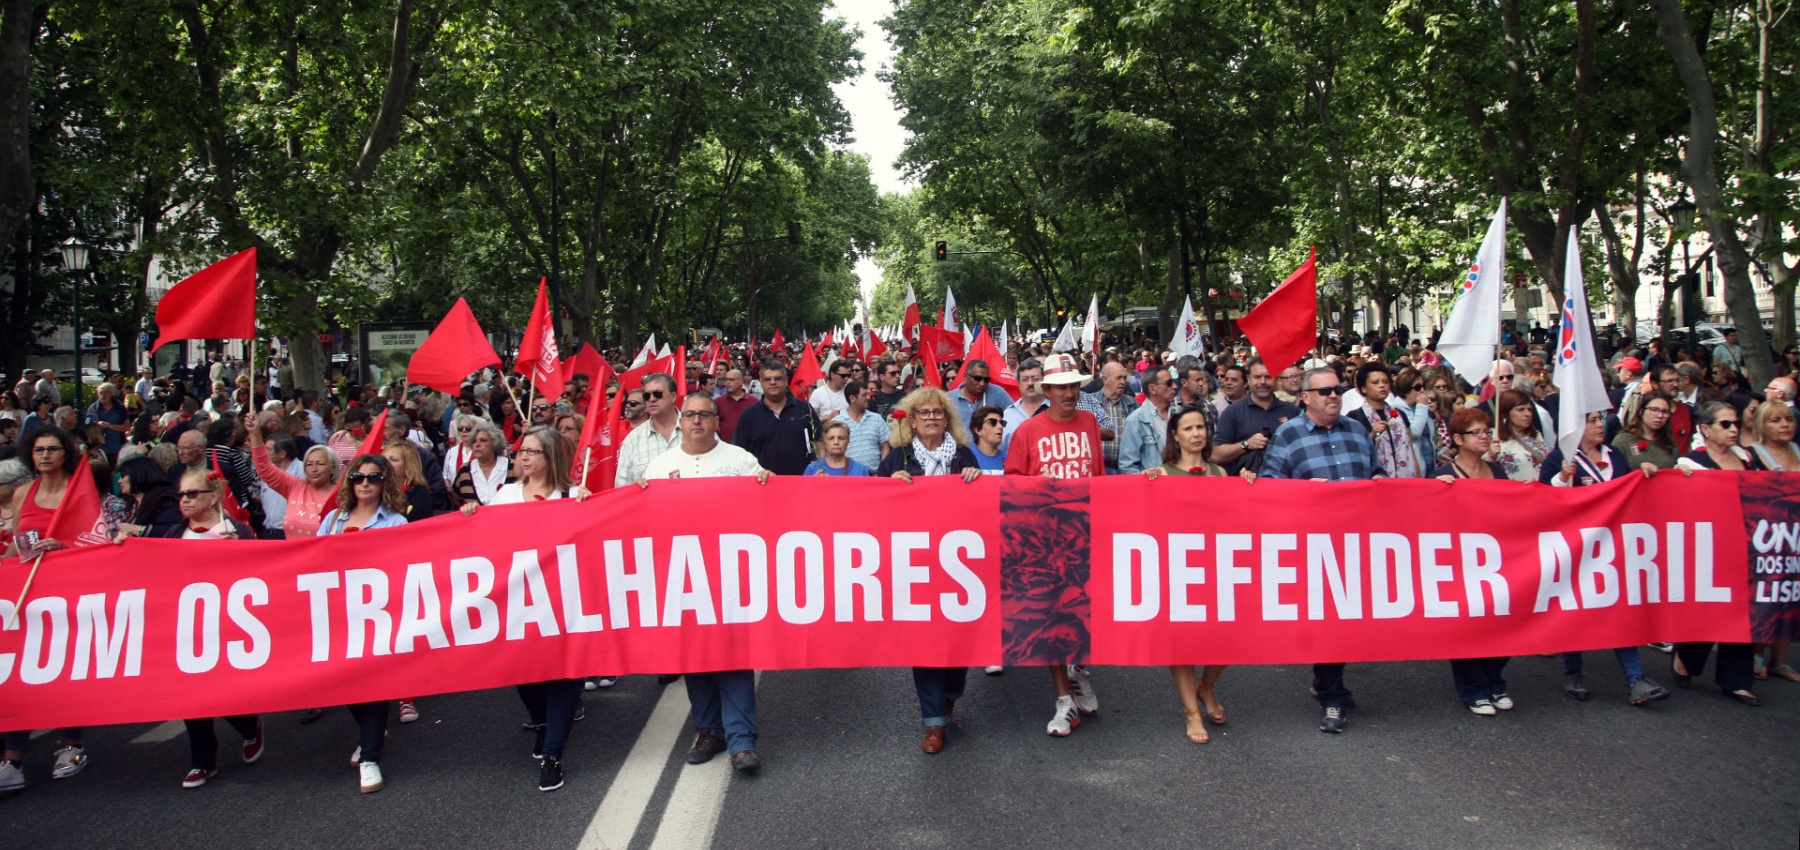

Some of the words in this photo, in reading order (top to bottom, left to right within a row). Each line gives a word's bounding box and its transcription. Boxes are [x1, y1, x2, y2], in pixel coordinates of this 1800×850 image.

[1038, 431, 1092, 462] CUBA
[1756, 556, 1783, 574] DOS
[176, 578, 271, 673] OS
[297, 530, 987, 662] TRABALHADORES
[1112, 532, 1509, 622] DEFENDER
[1534, 522, 1732, 612] ABRIL
[1755, 581, 1800, 603] LISB
